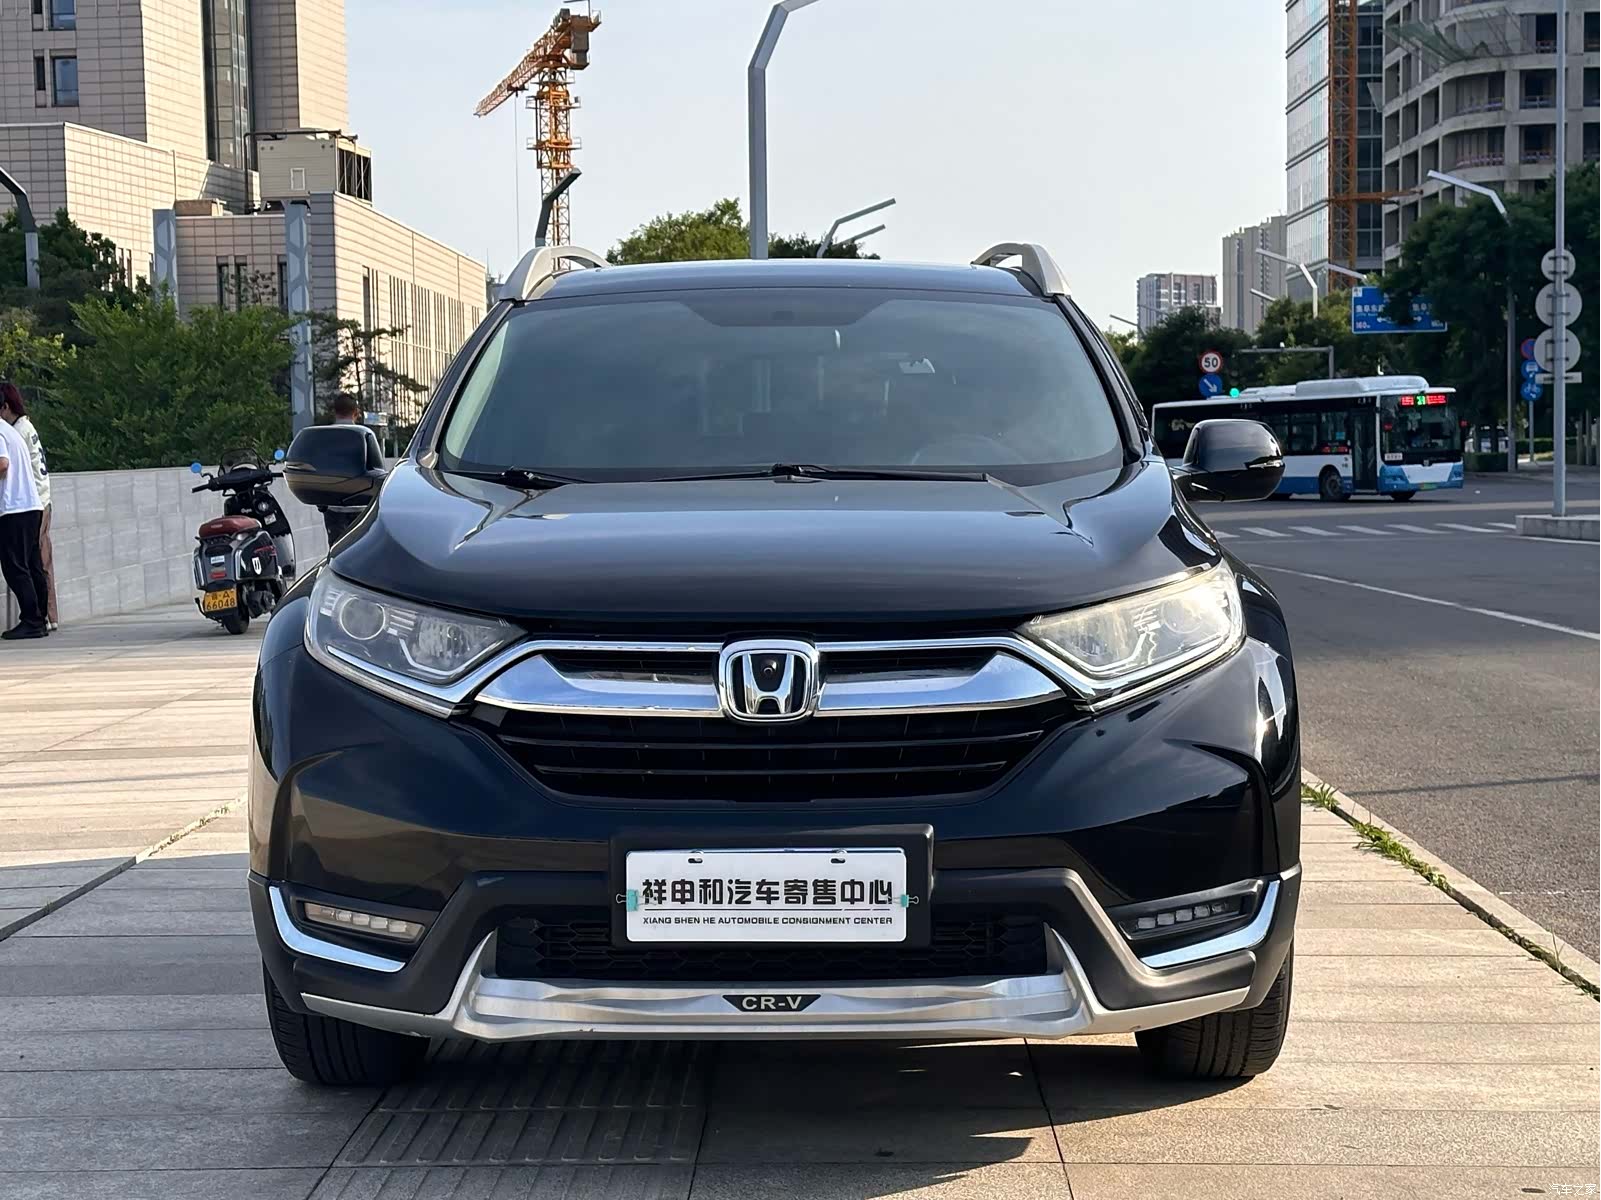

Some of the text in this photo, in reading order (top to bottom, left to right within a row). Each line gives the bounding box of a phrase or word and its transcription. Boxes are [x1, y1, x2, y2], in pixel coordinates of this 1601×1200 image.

[1204, 357, 1219, 368] 50
[206, 597, 236, 611] 66048
[642, 878, 893, 906] 祥申和汽车寄售中心
[643, 917, 893, 925] XIANG SHEN HE AUTOMOBILE CONSIGNMENT CENTER
[742, 996, 802, 1010] CR-V
